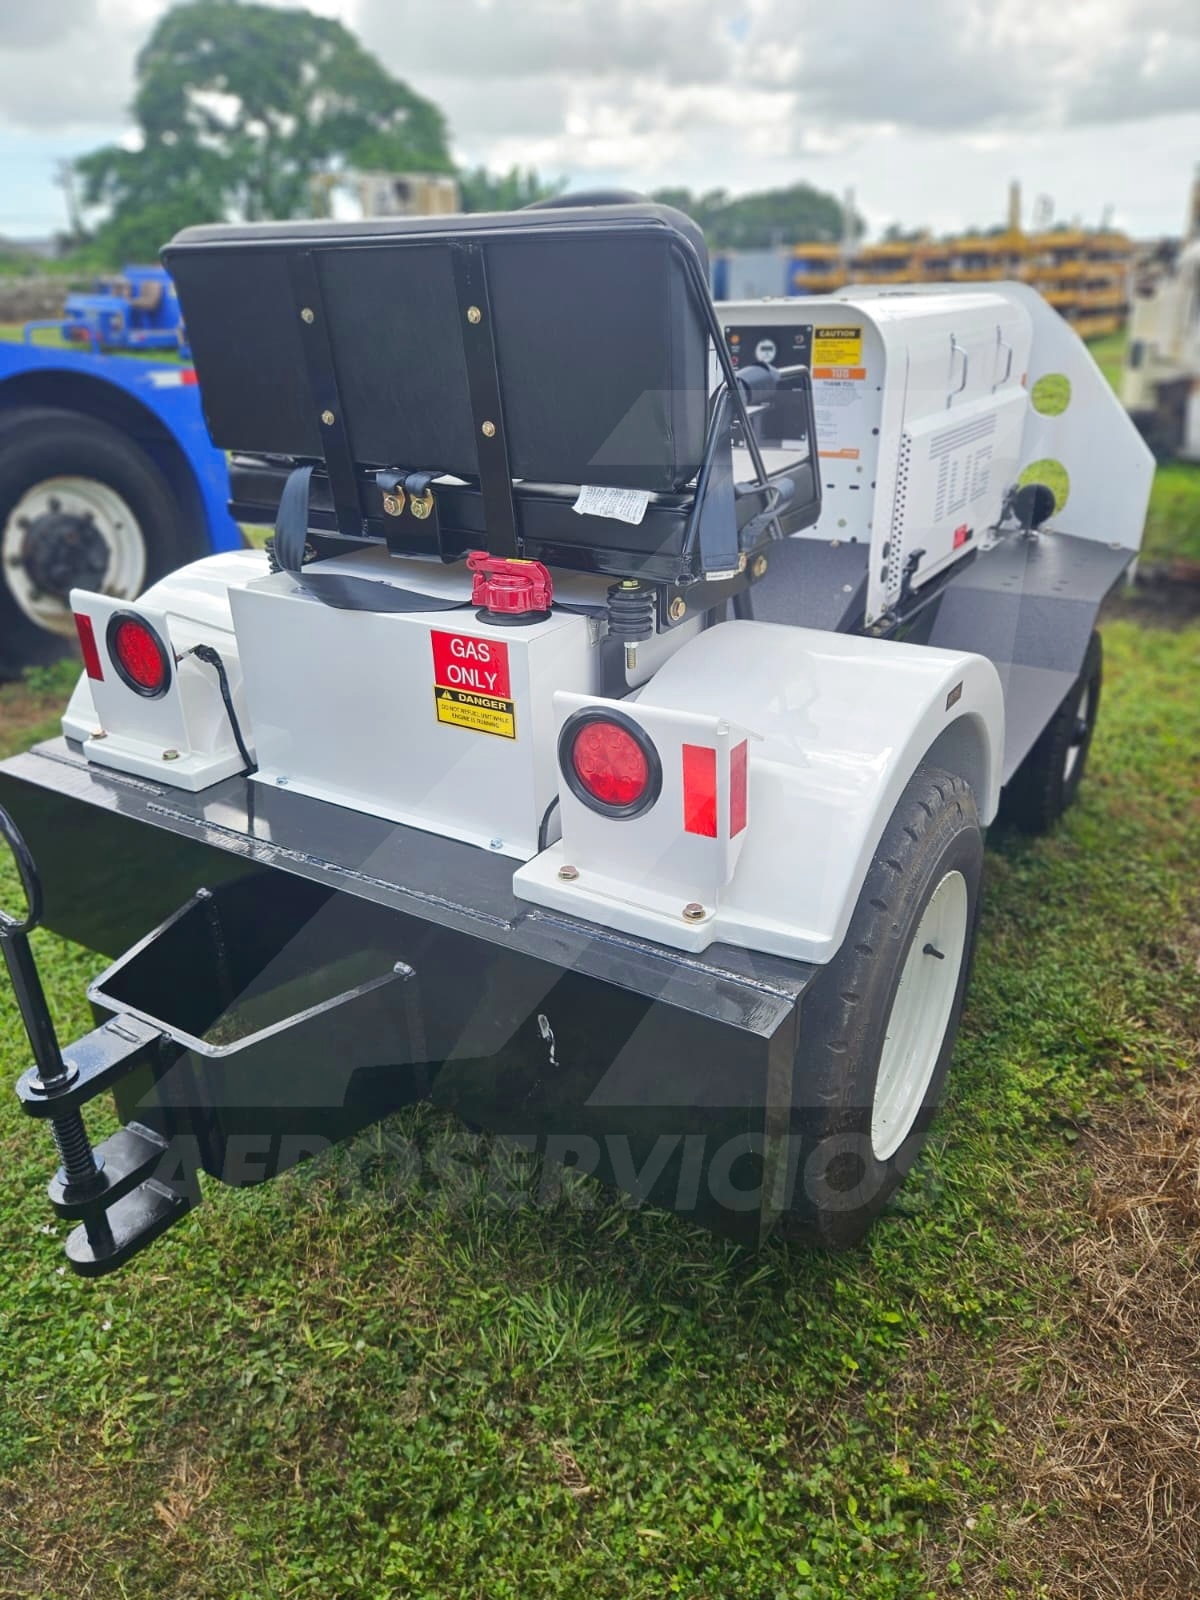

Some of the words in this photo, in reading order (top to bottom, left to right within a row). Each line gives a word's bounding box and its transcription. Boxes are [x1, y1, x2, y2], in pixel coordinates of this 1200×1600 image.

[819, 329, 856, 338] CAUTION
[450, 638, 491, 662] GAS
[447, 664, 497, 691] ONLY
[441, 703, 449, 711] DO
[450, 705, 460, 713] NOT
[458, 693, 507, 711] DANGER
[451, 713, 470, 723] ENGINE
